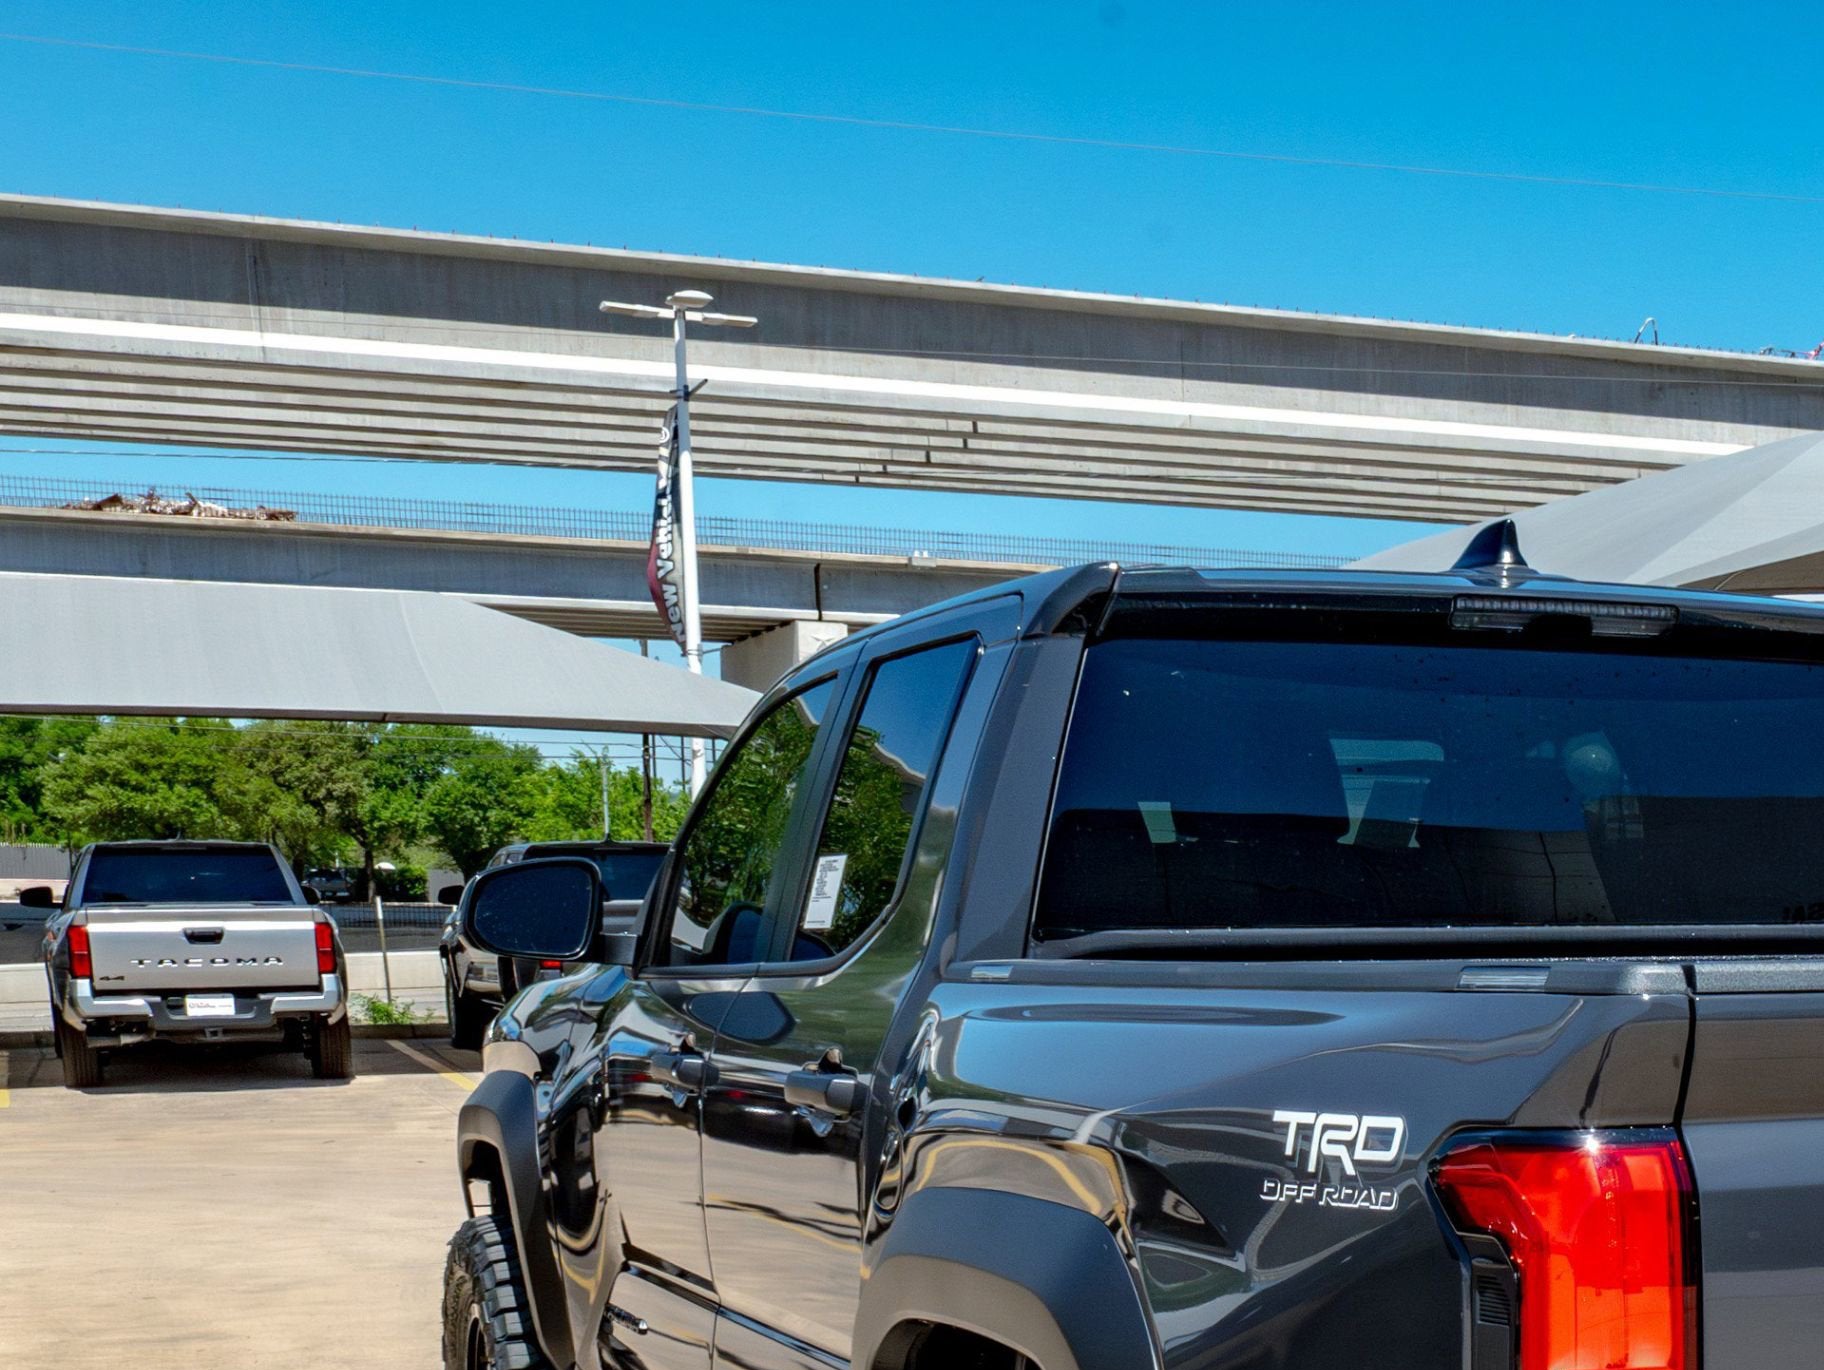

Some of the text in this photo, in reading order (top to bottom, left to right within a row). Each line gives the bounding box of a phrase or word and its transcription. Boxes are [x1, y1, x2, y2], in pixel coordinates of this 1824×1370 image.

[662, 583, 686, 642] New
[131, 957, 284, 969] TACOMA
[1272, 1110, 1404, 1176] TRD
[1259, 1178, 1399, 1212] OFF ROAD
